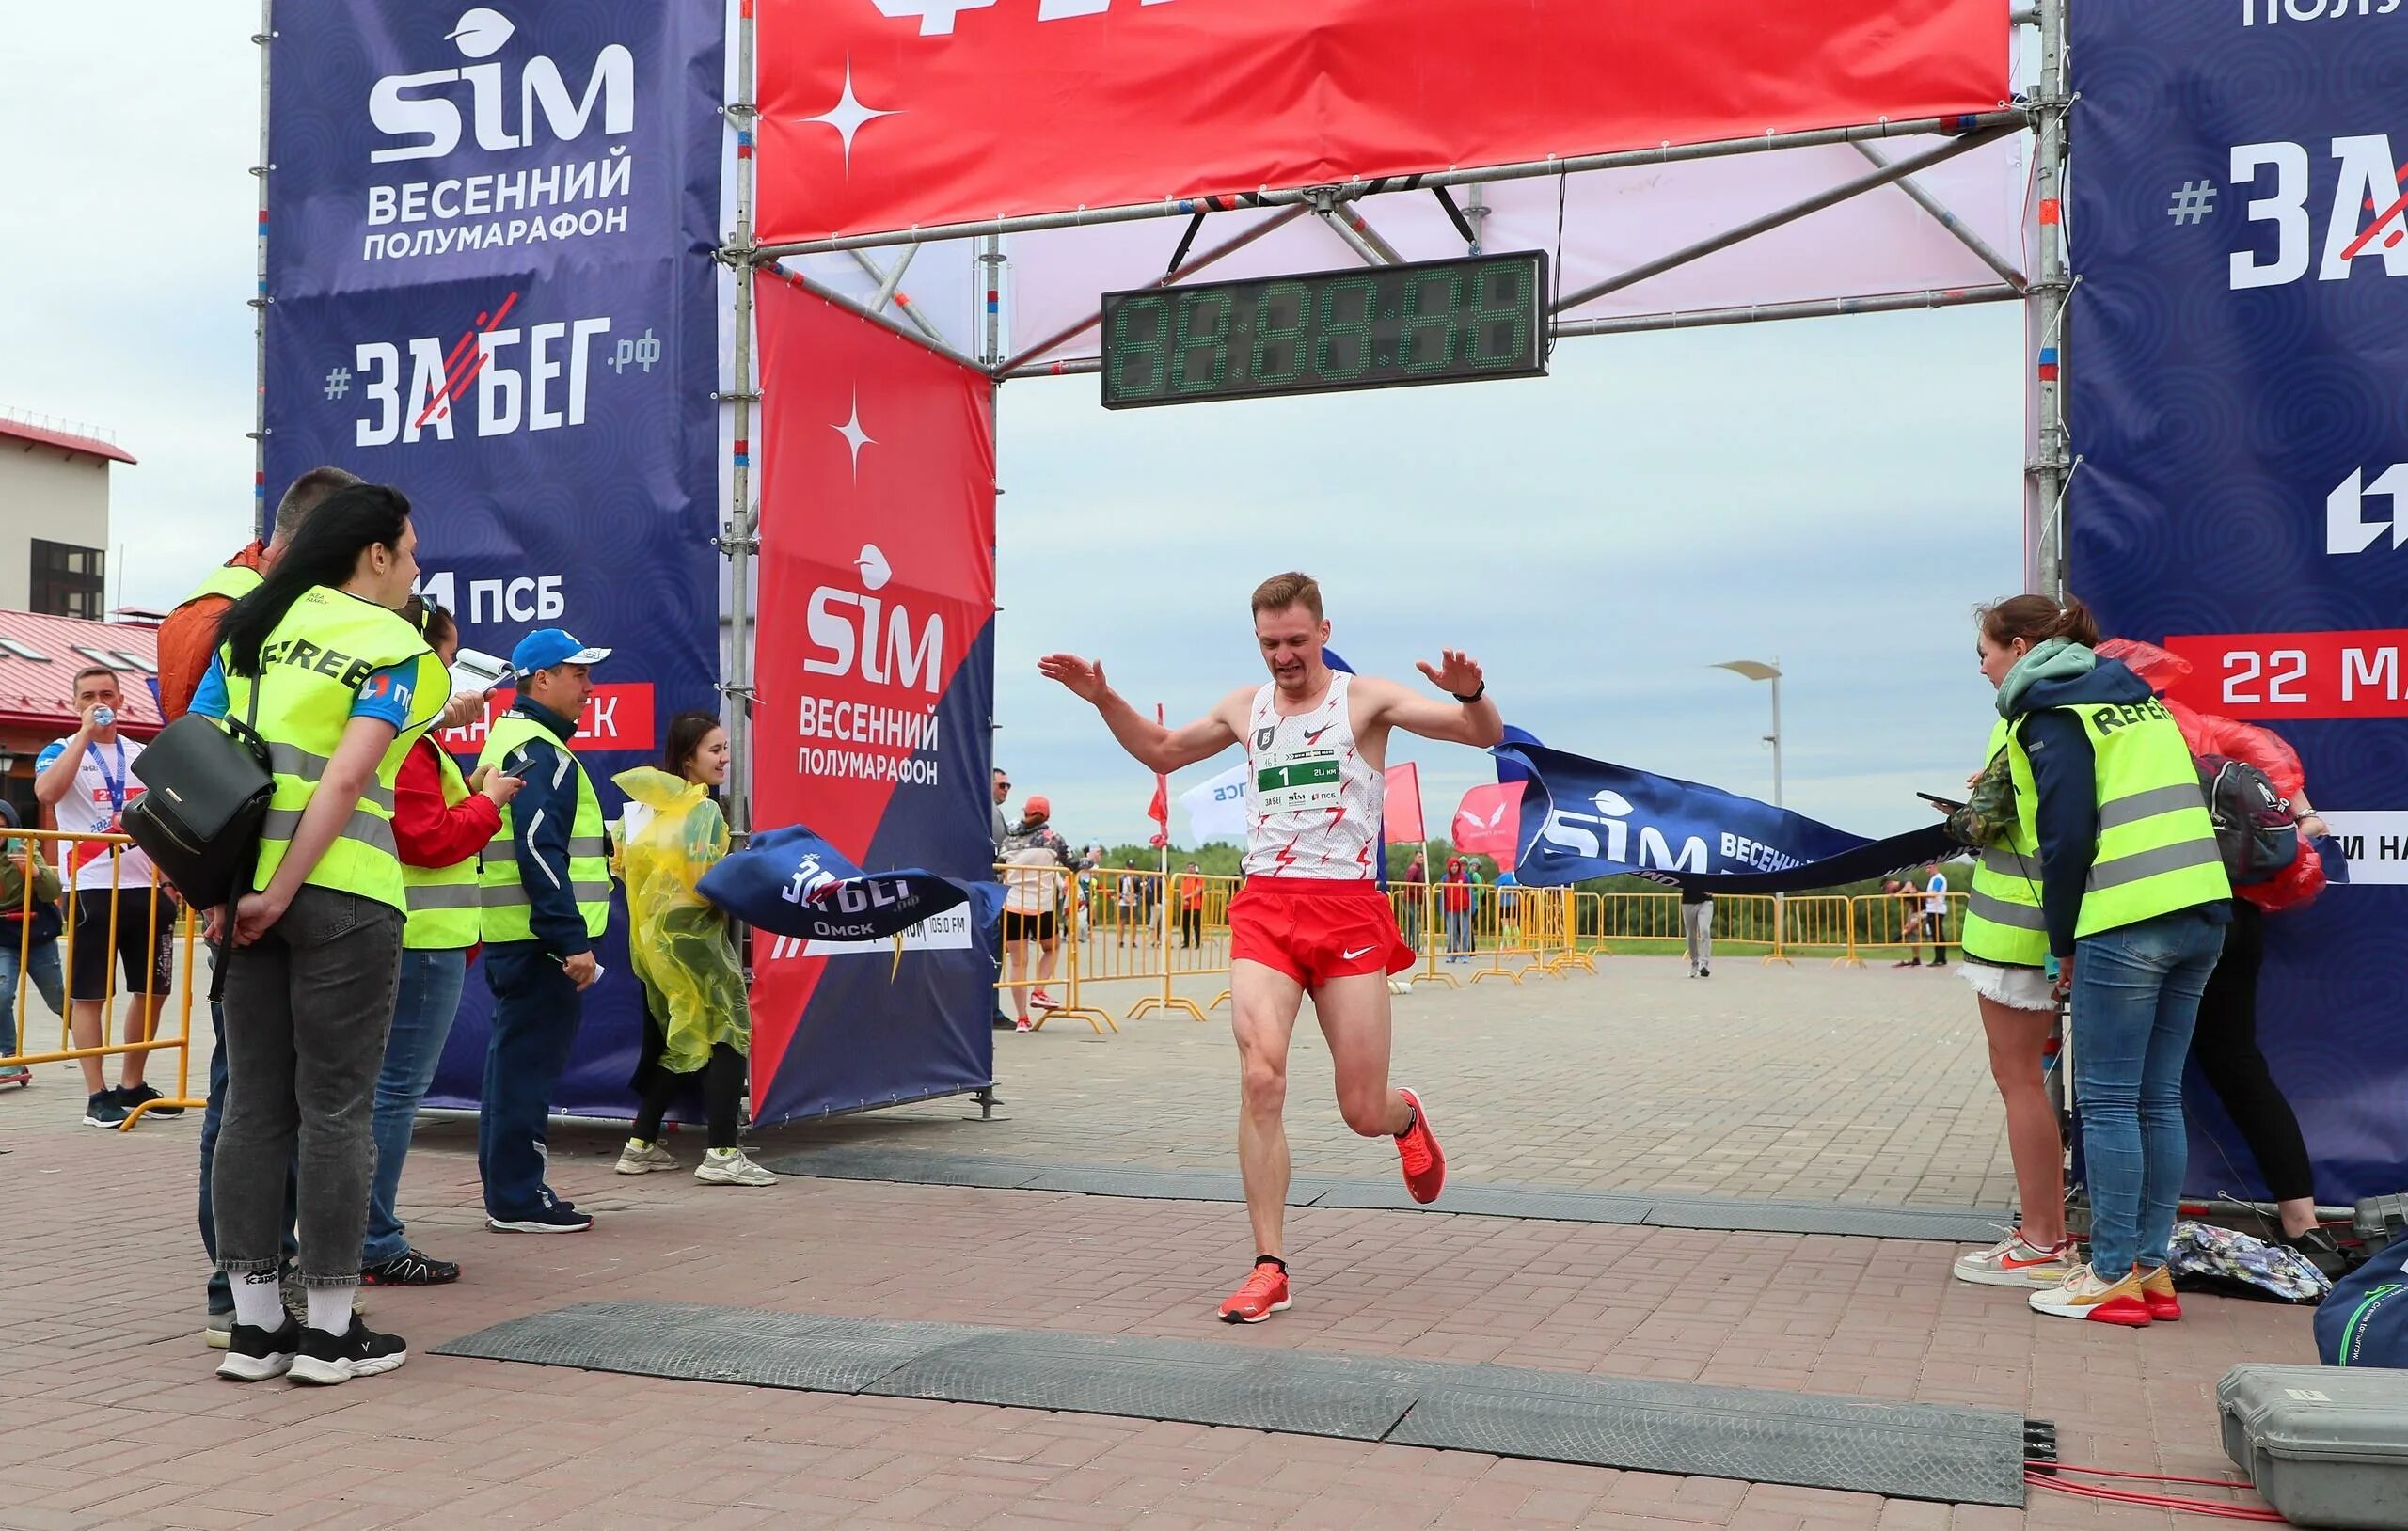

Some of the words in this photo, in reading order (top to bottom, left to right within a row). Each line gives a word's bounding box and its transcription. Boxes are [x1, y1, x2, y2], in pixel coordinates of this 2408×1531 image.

[367, 145, 633, 227] ВЕСЕННИЙ
[363, 206, 628, 261] ПОЛУМАРАФОН
[469, 575, 565, 624] ПСБ
[2223, 650, 2307, 704] 22
[2341, 646, 2408, 702] М
[800, 695, 940, 752] ВЕСЕННИЙ
[798, 746, 939, 786] ПОЛУМАРАФОН
[1278, 766, 1290, 787] 1
[928, 917, 949, 934] 105.0
[952, 917, 965, 934] FM
